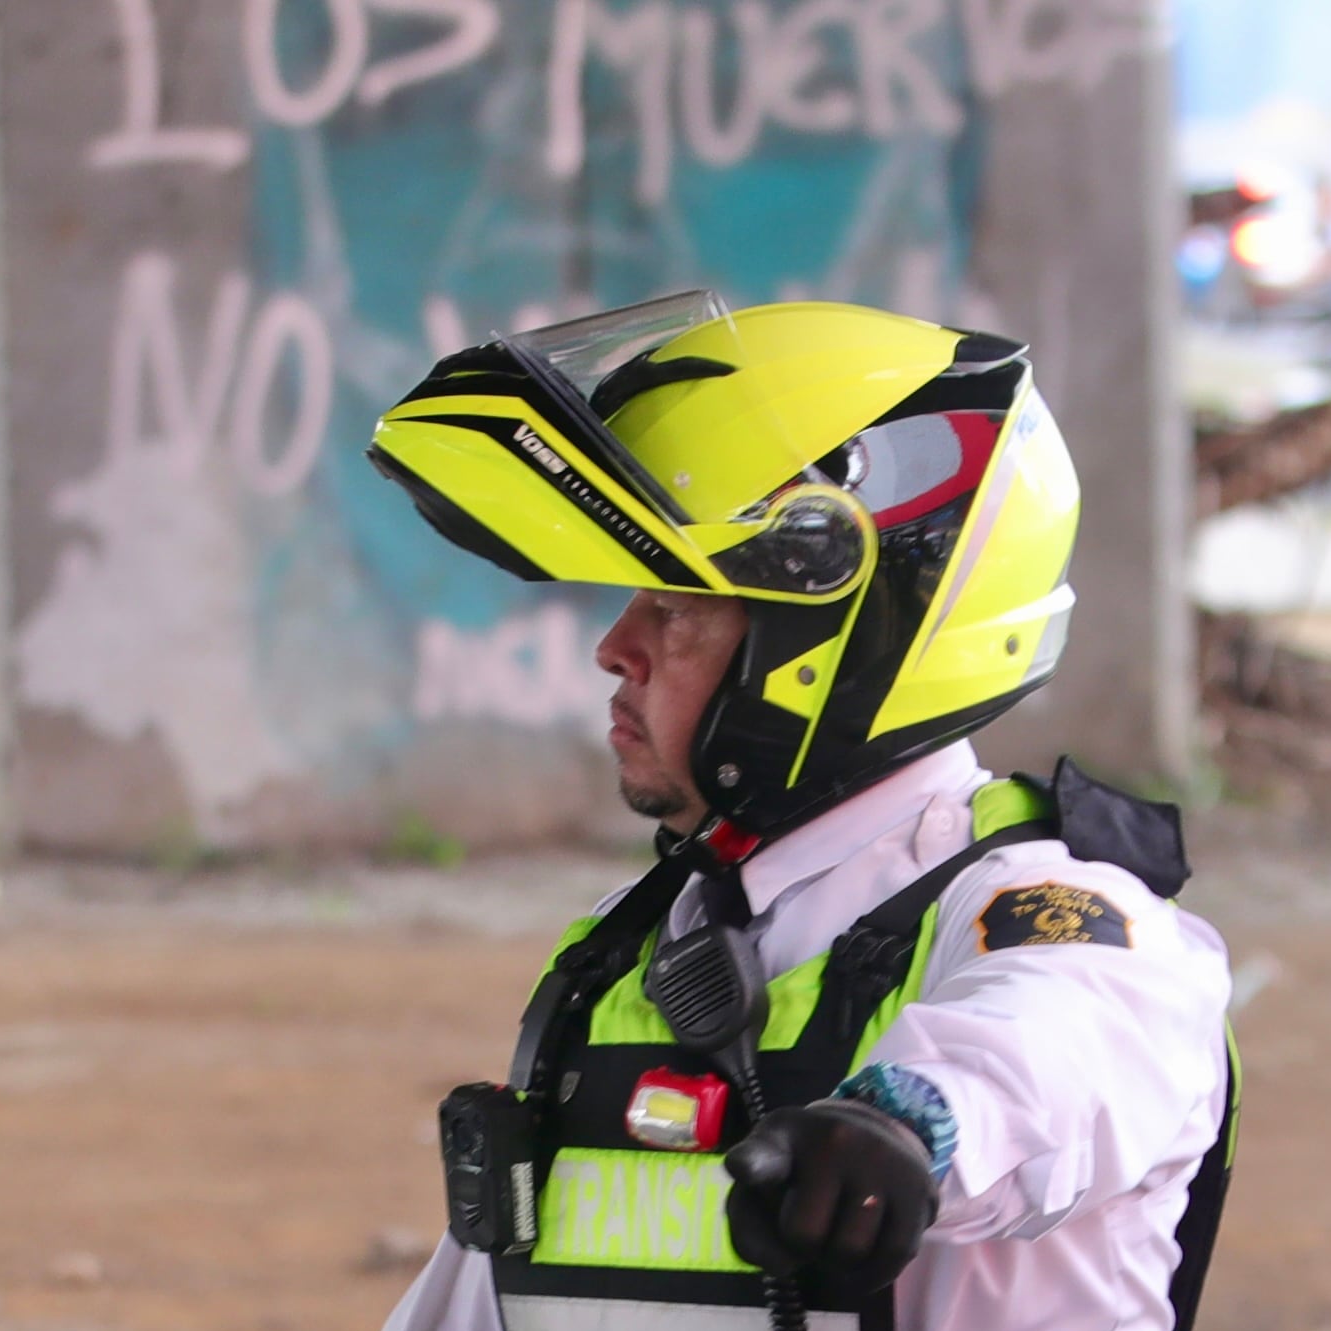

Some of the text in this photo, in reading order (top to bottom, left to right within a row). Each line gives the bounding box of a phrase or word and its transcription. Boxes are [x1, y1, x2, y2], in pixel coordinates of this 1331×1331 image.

[107, 252, 333, 498] NO
[512, 423, 569, 475] VOSS
[552, 1160, 737, 1262] TRANSIT
